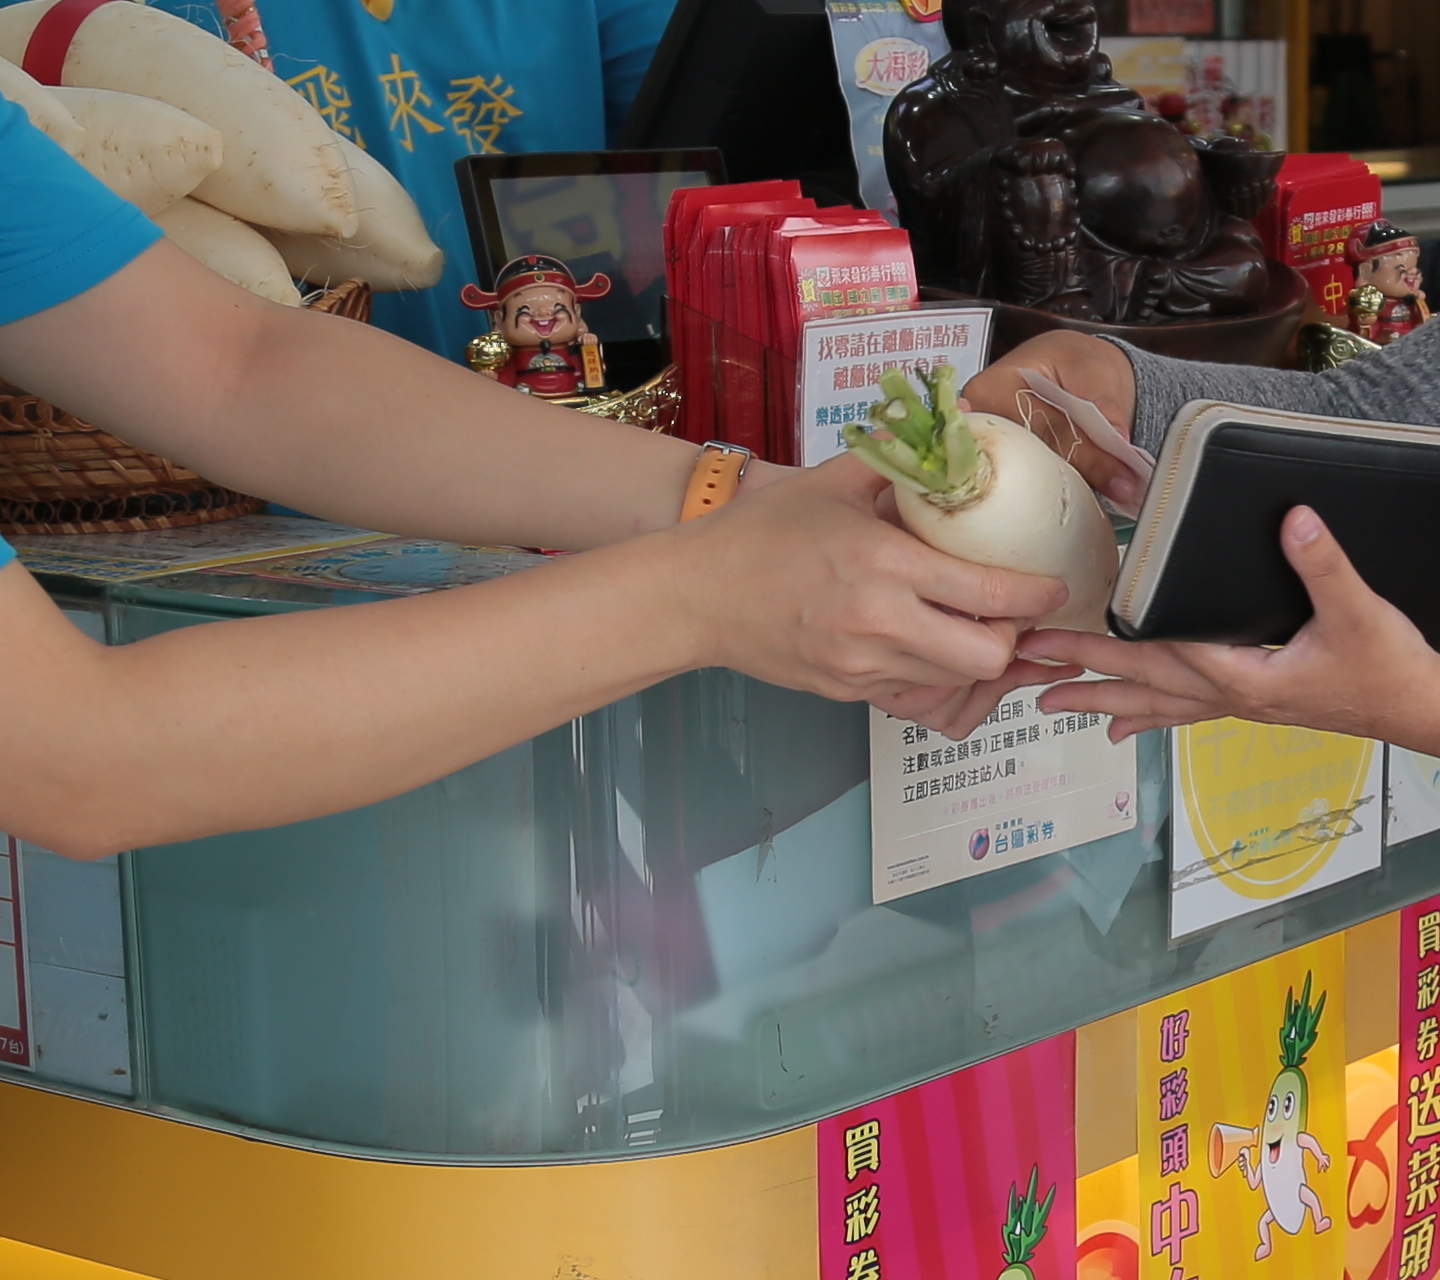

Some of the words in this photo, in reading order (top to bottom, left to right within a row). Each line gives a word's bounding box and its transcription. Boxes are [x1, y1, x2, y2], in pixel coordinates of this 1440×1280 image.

[860, 50, 927, 83] 大福彩
[818, 324, 970, 361] 找零請在離櫃前點清
